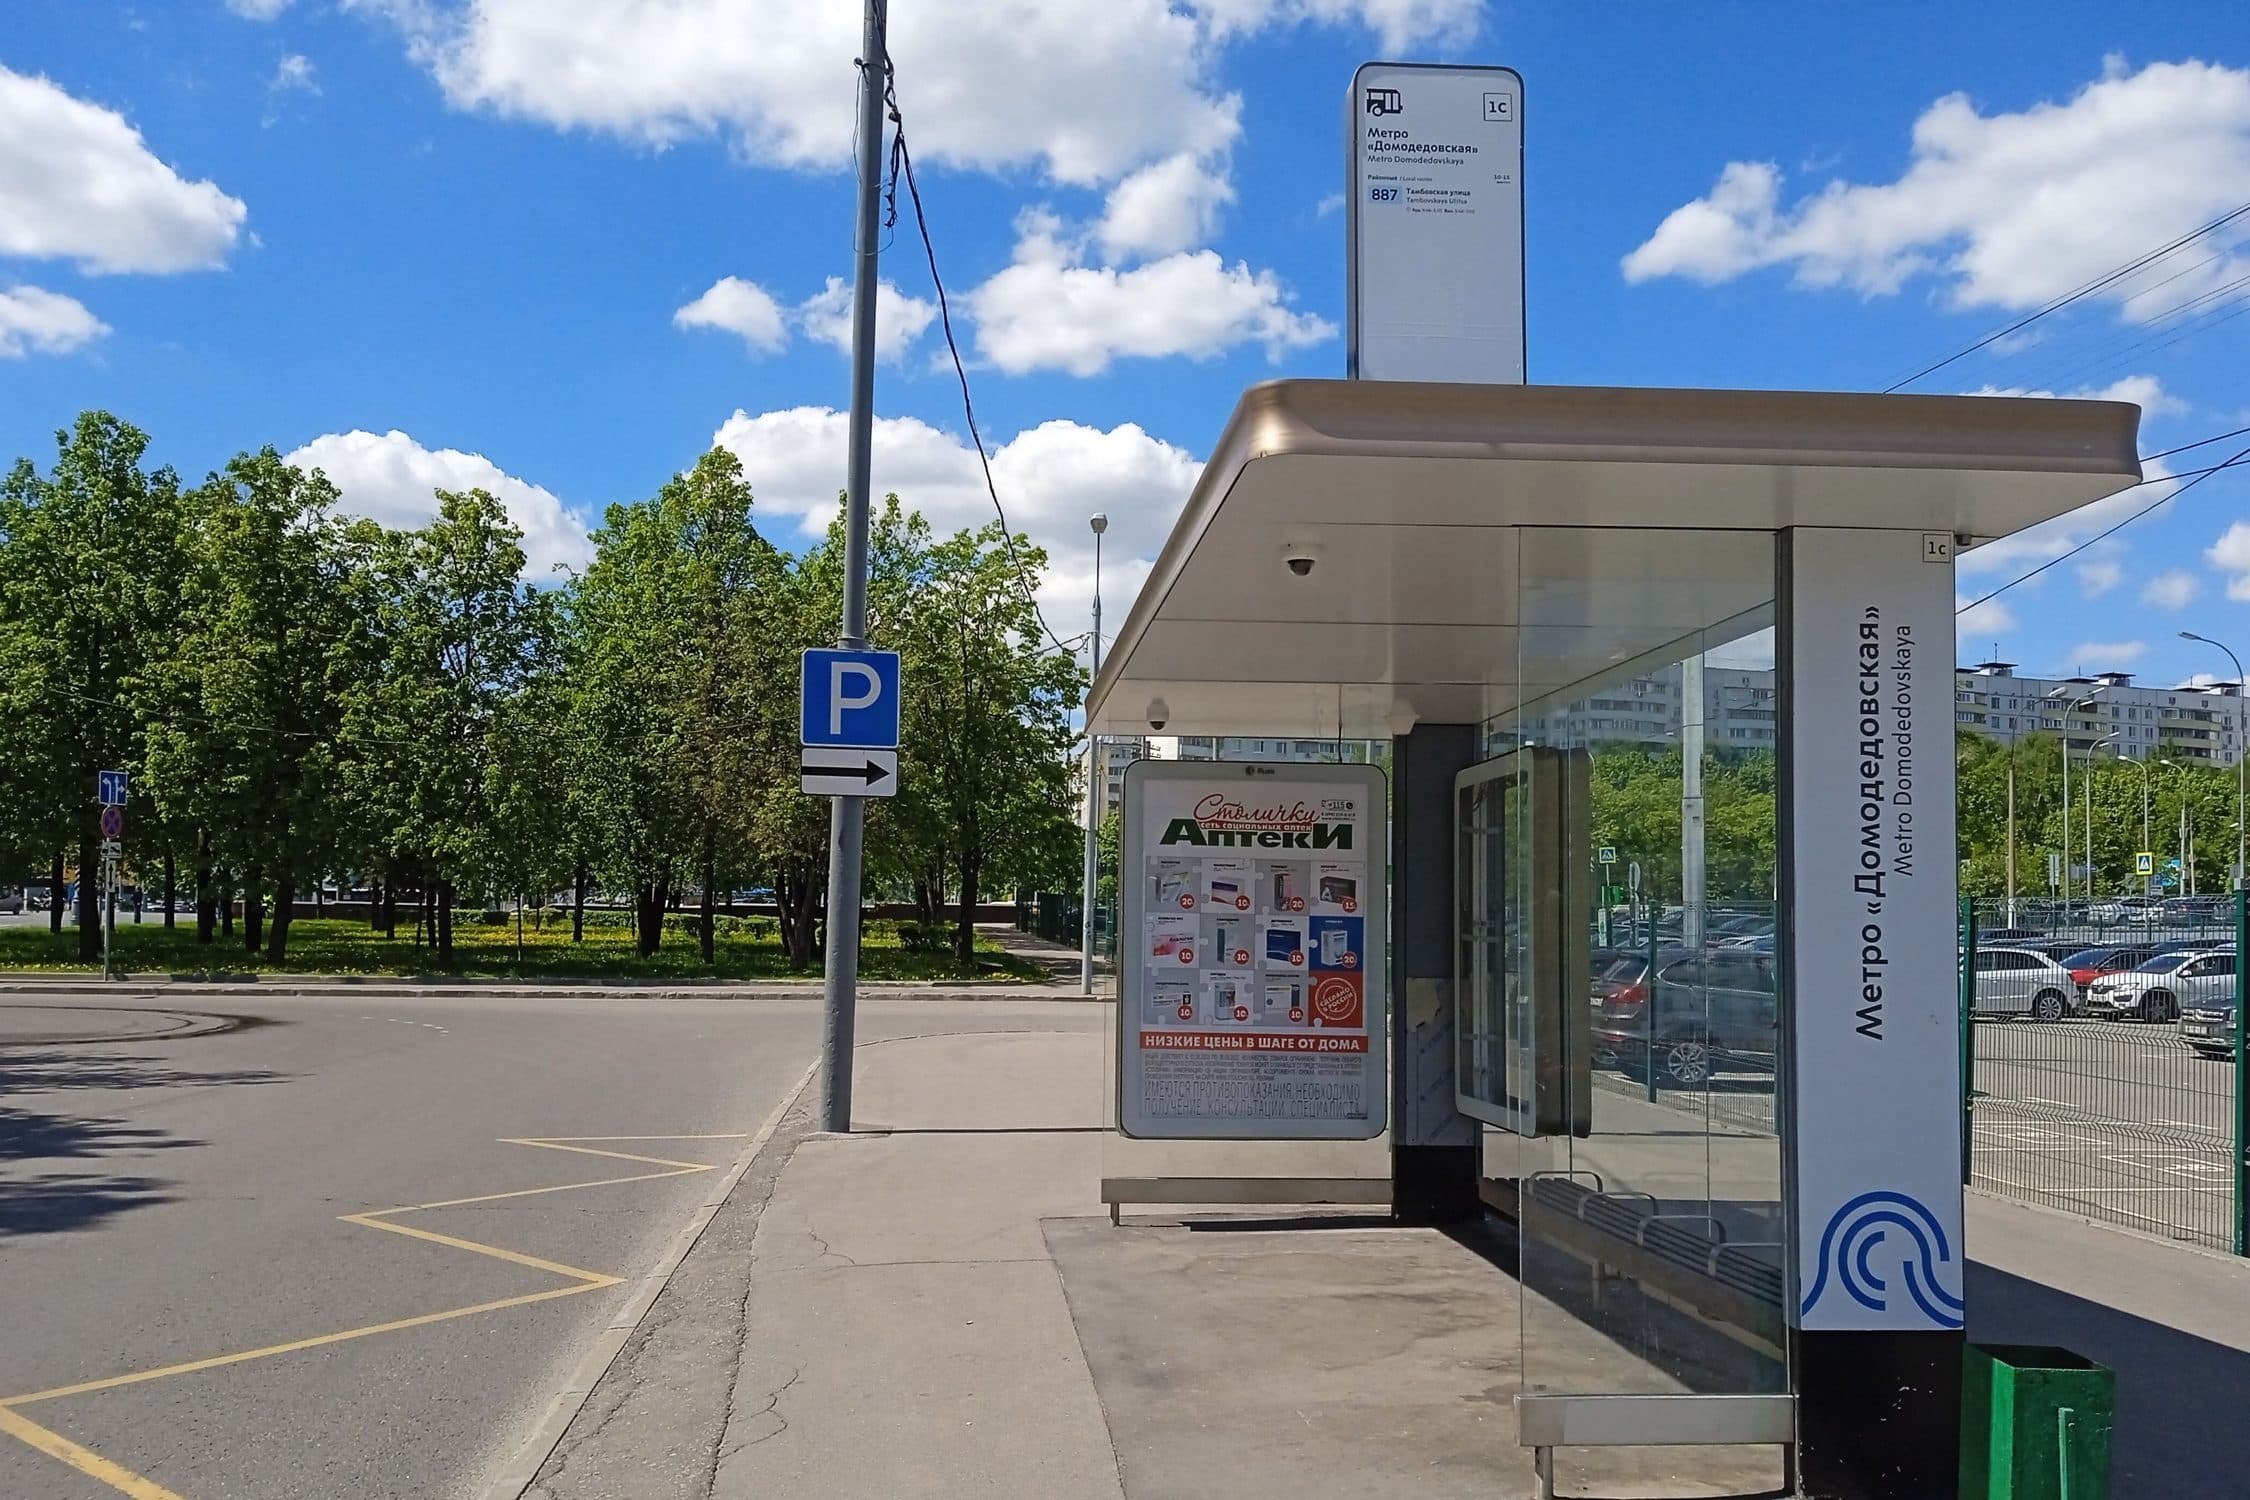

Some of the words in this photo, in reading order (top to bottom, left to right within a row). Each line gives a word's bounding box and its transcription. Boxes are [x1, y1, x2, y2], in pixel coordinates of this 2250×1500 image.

[1367, 128, 1409, 140] Метро
[1367, 141, 1478, 154] «Домодедовская»
[1367, 155, 1392, 163] Metro
[1394, 156, 1464, 166] Domodedovskaya
[1371, 188, 1398, 201] 887
[1406, 188, 1448, 197] Тамбовская
[829, 661, 882, 735] P
[1891, 625, 1916, 806] Domodedovskaya
[1854, 605, 1887, 915] «Домодедовская»
[1193, 793, 1321, 823] Столички
[1200, 821, 1221, 830] сеть
[1222, 822, 1282, 832] социальных
[1284, 823, 1313, 833] аптек
[1893, 812, 1913, 877] Metro
[1855, 923, 1889, 1041] Метро
[1320, 987, 1350, 1008] СДЕЛАНО
[1145, 1035, 1200, 1047] НИЗКИЕ
[1204, 1036, 1242, 1048] ЦЕНЫ
[1246, 1037, 1255, 1048] В
[1258, 1038, 1295, 1049] ШАГЕ
[1298, 1039, 1316, 1049] ОТ
[1318, 1039, 1360, 1051] ДОМА
[1145, 1098, 1201, 1116] ПОЛУЧЕНИЕ
